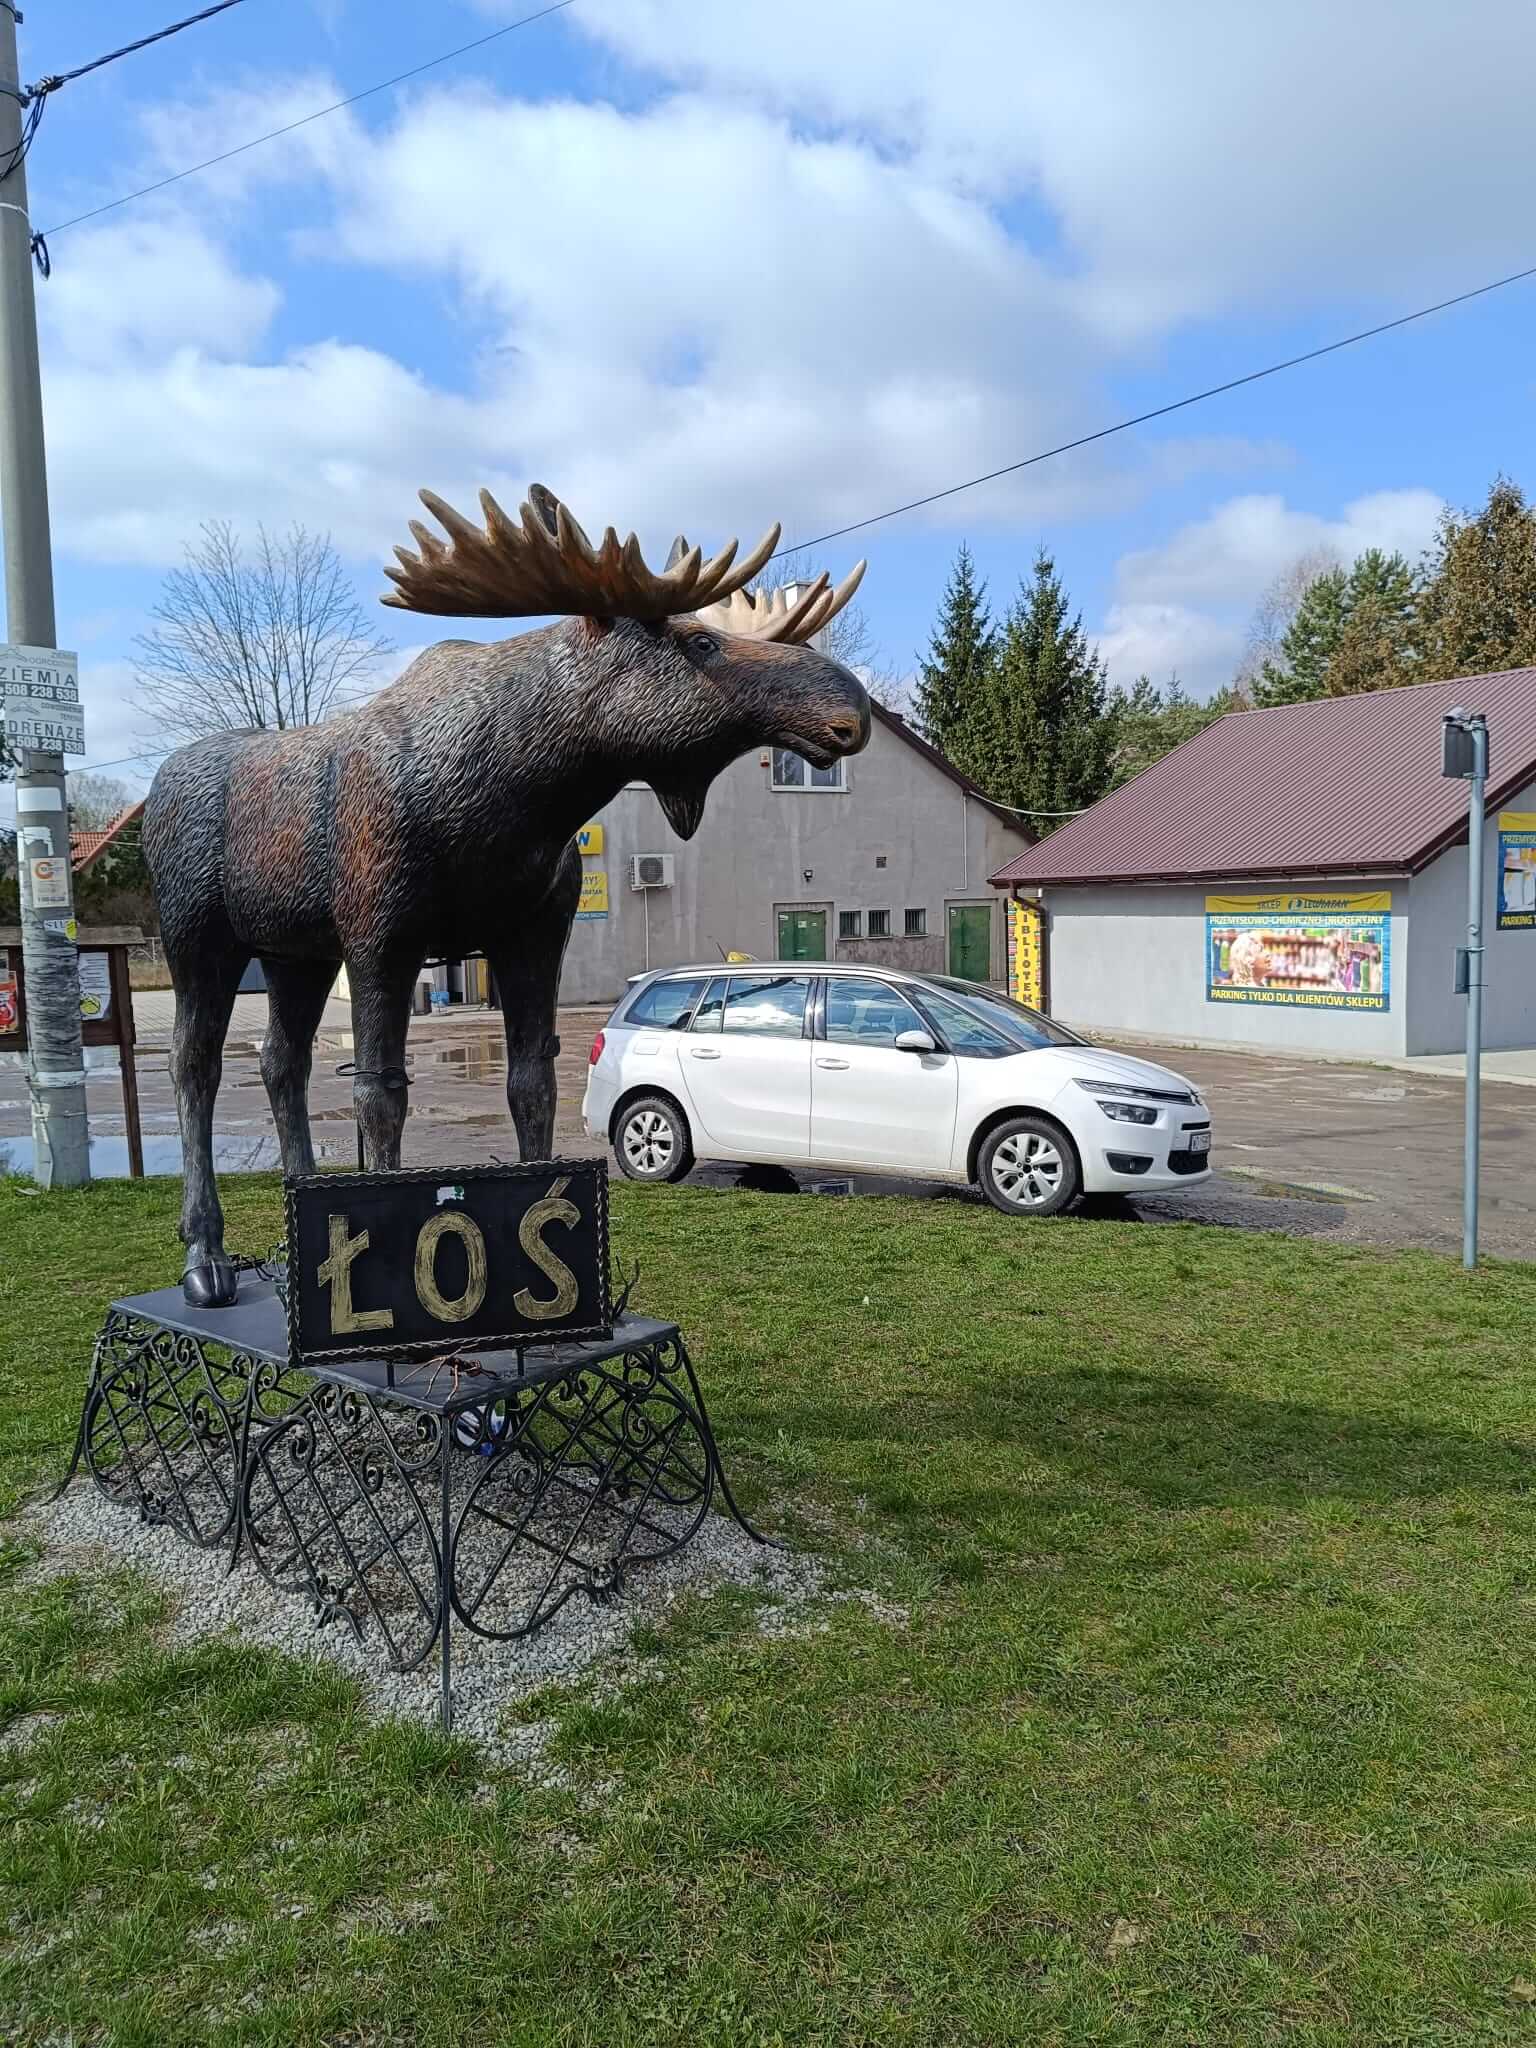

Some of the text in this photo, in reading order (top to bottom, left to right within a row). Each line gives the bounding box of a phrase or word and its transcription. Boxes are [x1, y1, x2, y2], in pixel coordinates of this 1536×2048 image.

[0, 667, 76, 686] ZIEMIA
[5, 684, 77, 701] 508 238 538
[16, 736, 39, 748] 508
[42, 738, 63, 751] 238
[1022, 903, 1032, 1007] BIBLIOTEK
[1210, 989, 1384, 1009] PARKING TYLKO DLA KLIENTÓW SKLEPU
[317, 1176, 582, 1336] ŁOŚ
